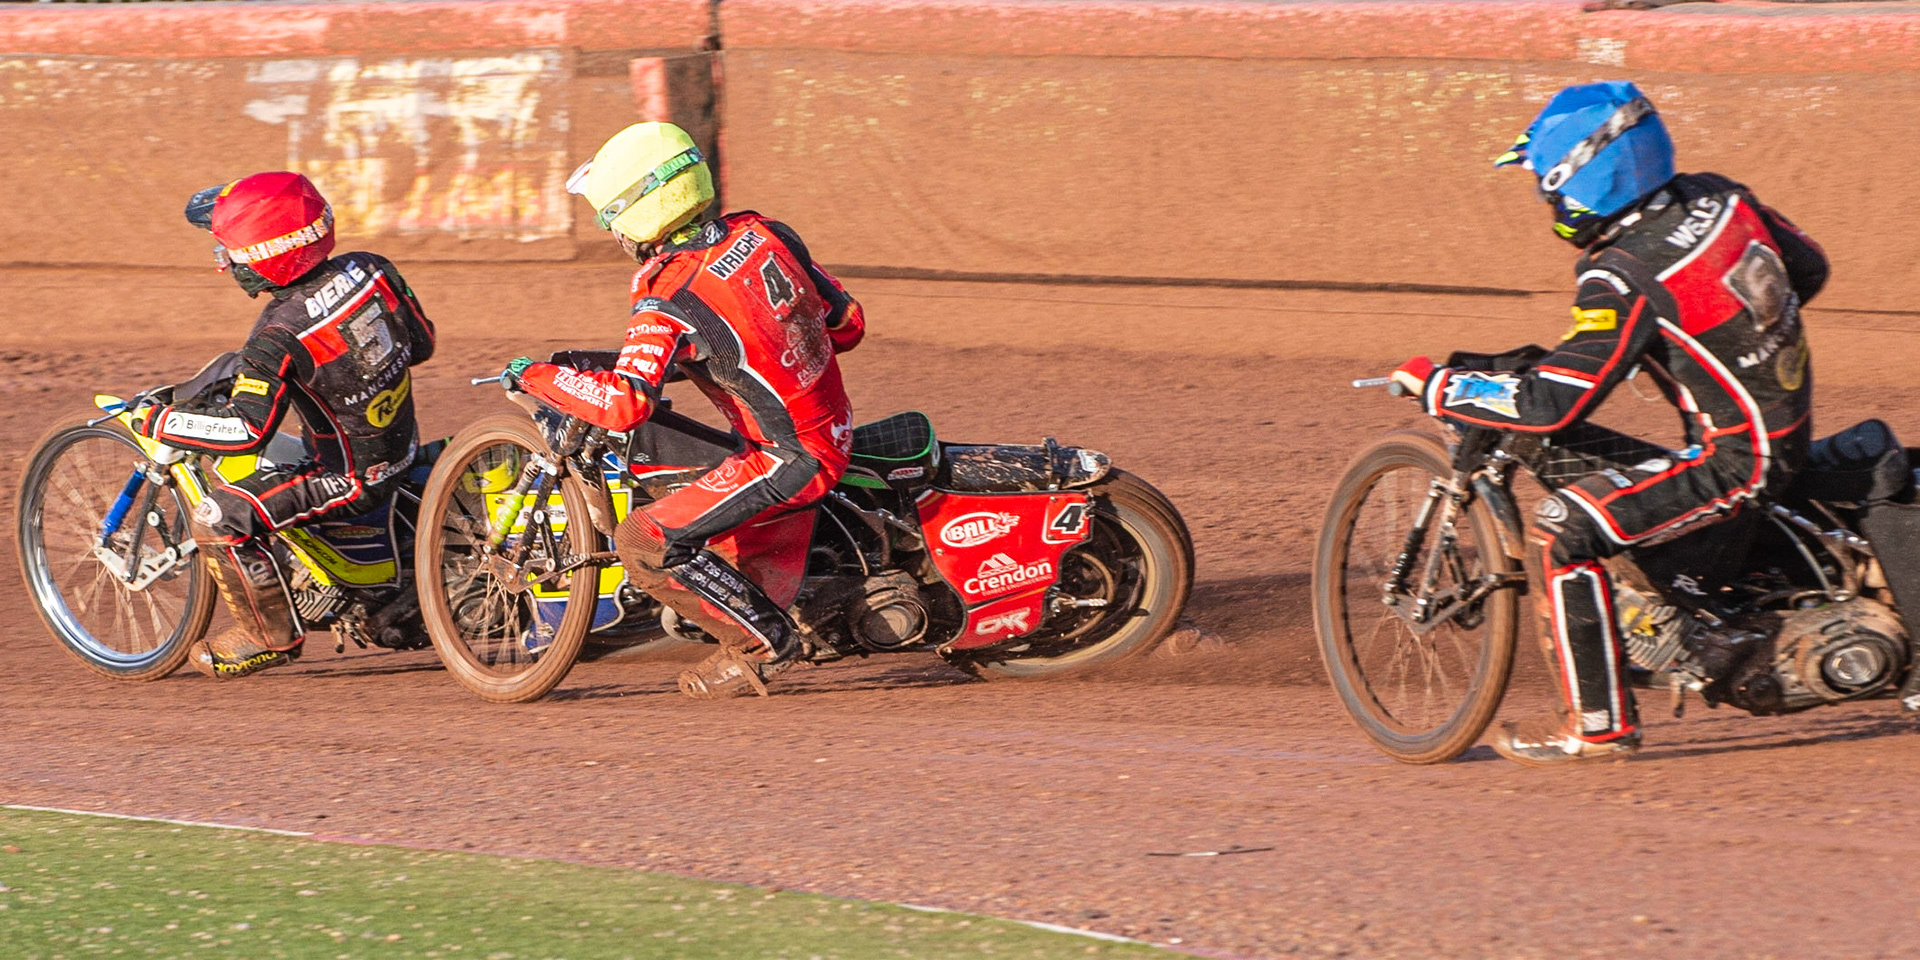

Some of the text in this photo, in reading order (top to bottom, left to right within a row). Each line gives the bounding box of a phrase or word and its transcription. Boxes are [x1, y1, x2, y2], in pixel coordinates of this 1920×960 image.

[708, 230, 765, 280] WRIGHT
[760, 257, 796, 311] 4
[349, 301, 393, 366] 5
[344, 346, 411, 406] MANCHESTE
[1051, 503, 1085, 534] 4
[963, 562, 1052, 595] Crendon
